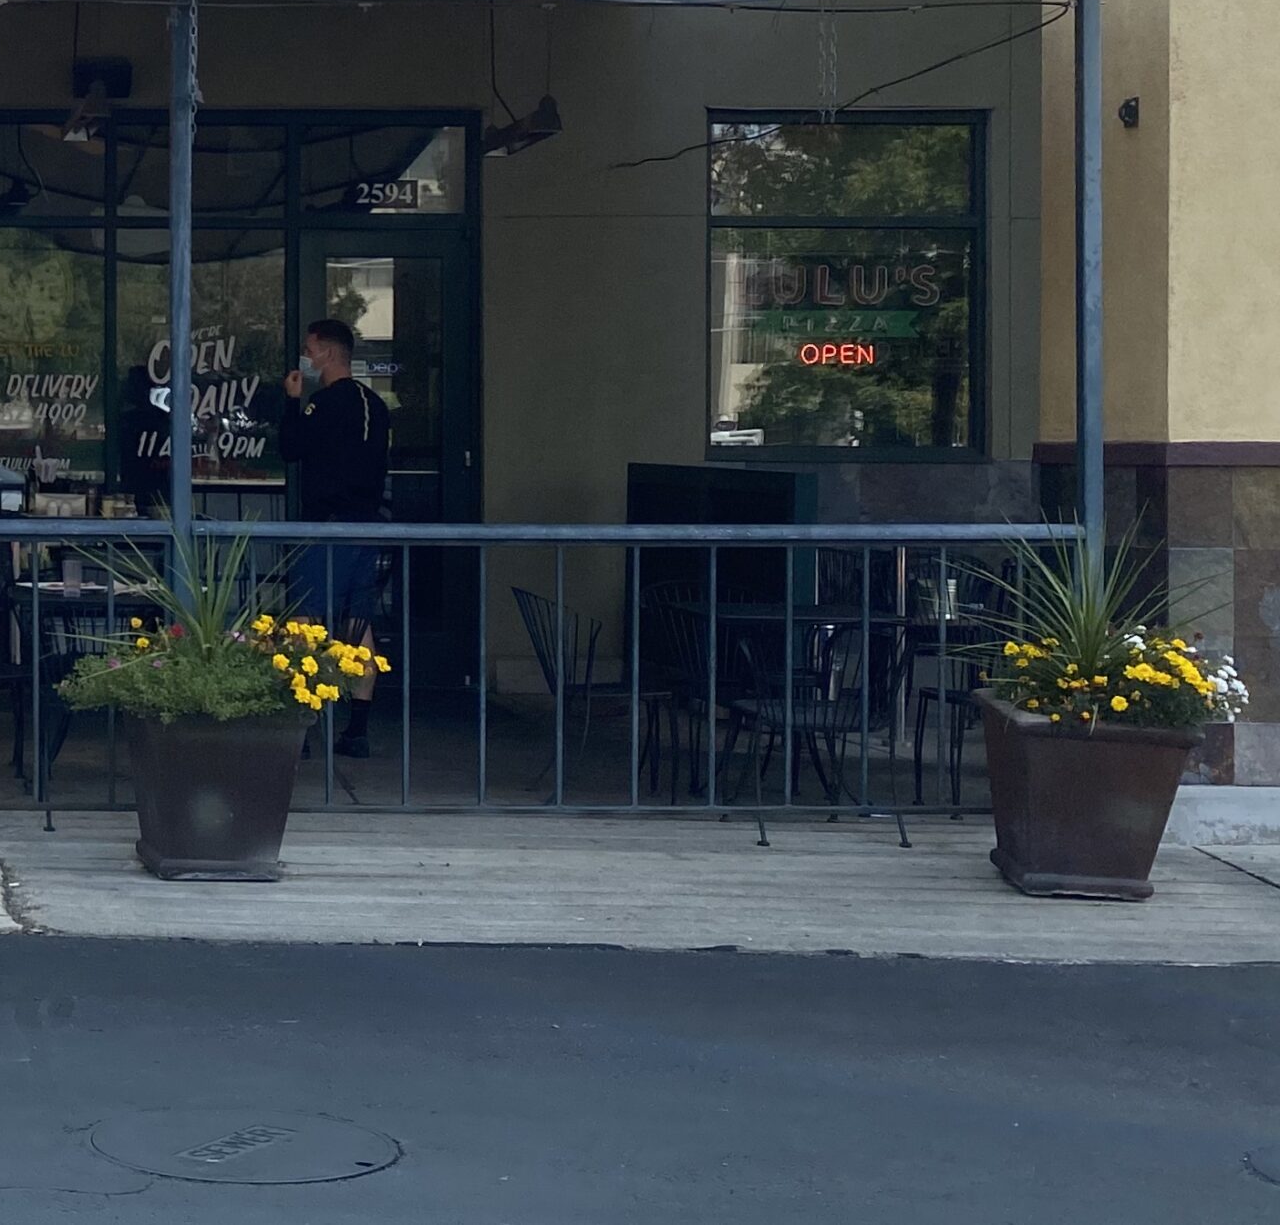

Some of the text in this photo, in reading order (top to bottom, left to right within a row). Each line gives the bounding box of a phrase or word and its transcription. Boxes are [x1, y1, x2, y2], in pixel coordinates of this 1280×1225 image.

[355, 182, 413, 204] 2594
[800, 343, 875, 365] OPEN
[6, 374, 99, 399] DELIVERY
[34, 402, 87, 426] 4992
[218, 431, 266, 459] 9PM
